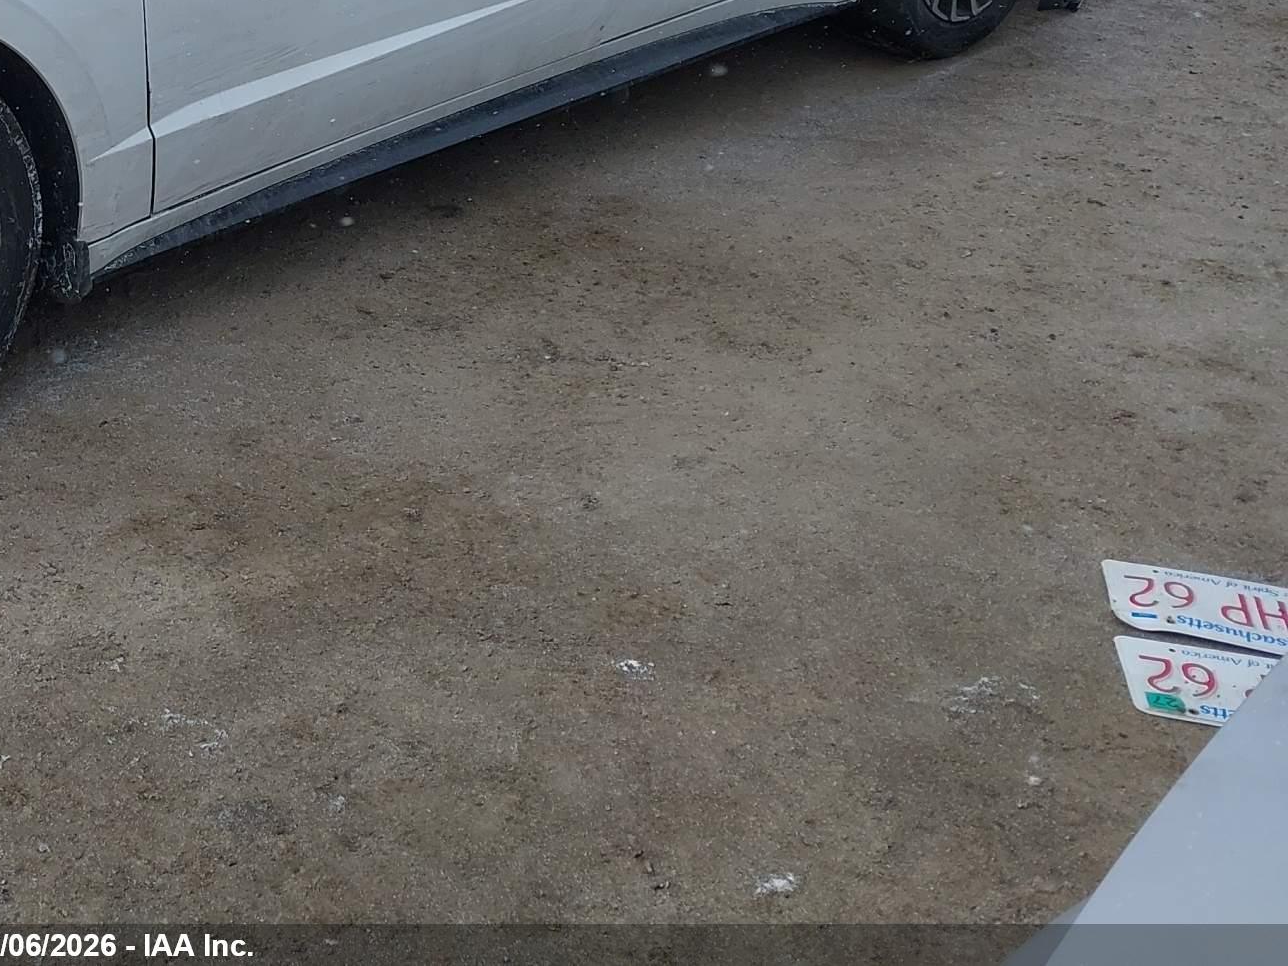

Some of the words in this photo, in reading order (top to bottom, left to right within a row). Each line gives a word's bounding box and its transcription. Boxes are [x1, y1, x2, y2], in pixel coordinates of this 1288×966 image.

[1123, 574, 1195, 609] 62
[1164, 571, 1221, 586] America
[1181, 649, 1242, 666] America
[1138, 654, 1216, 698] 62
